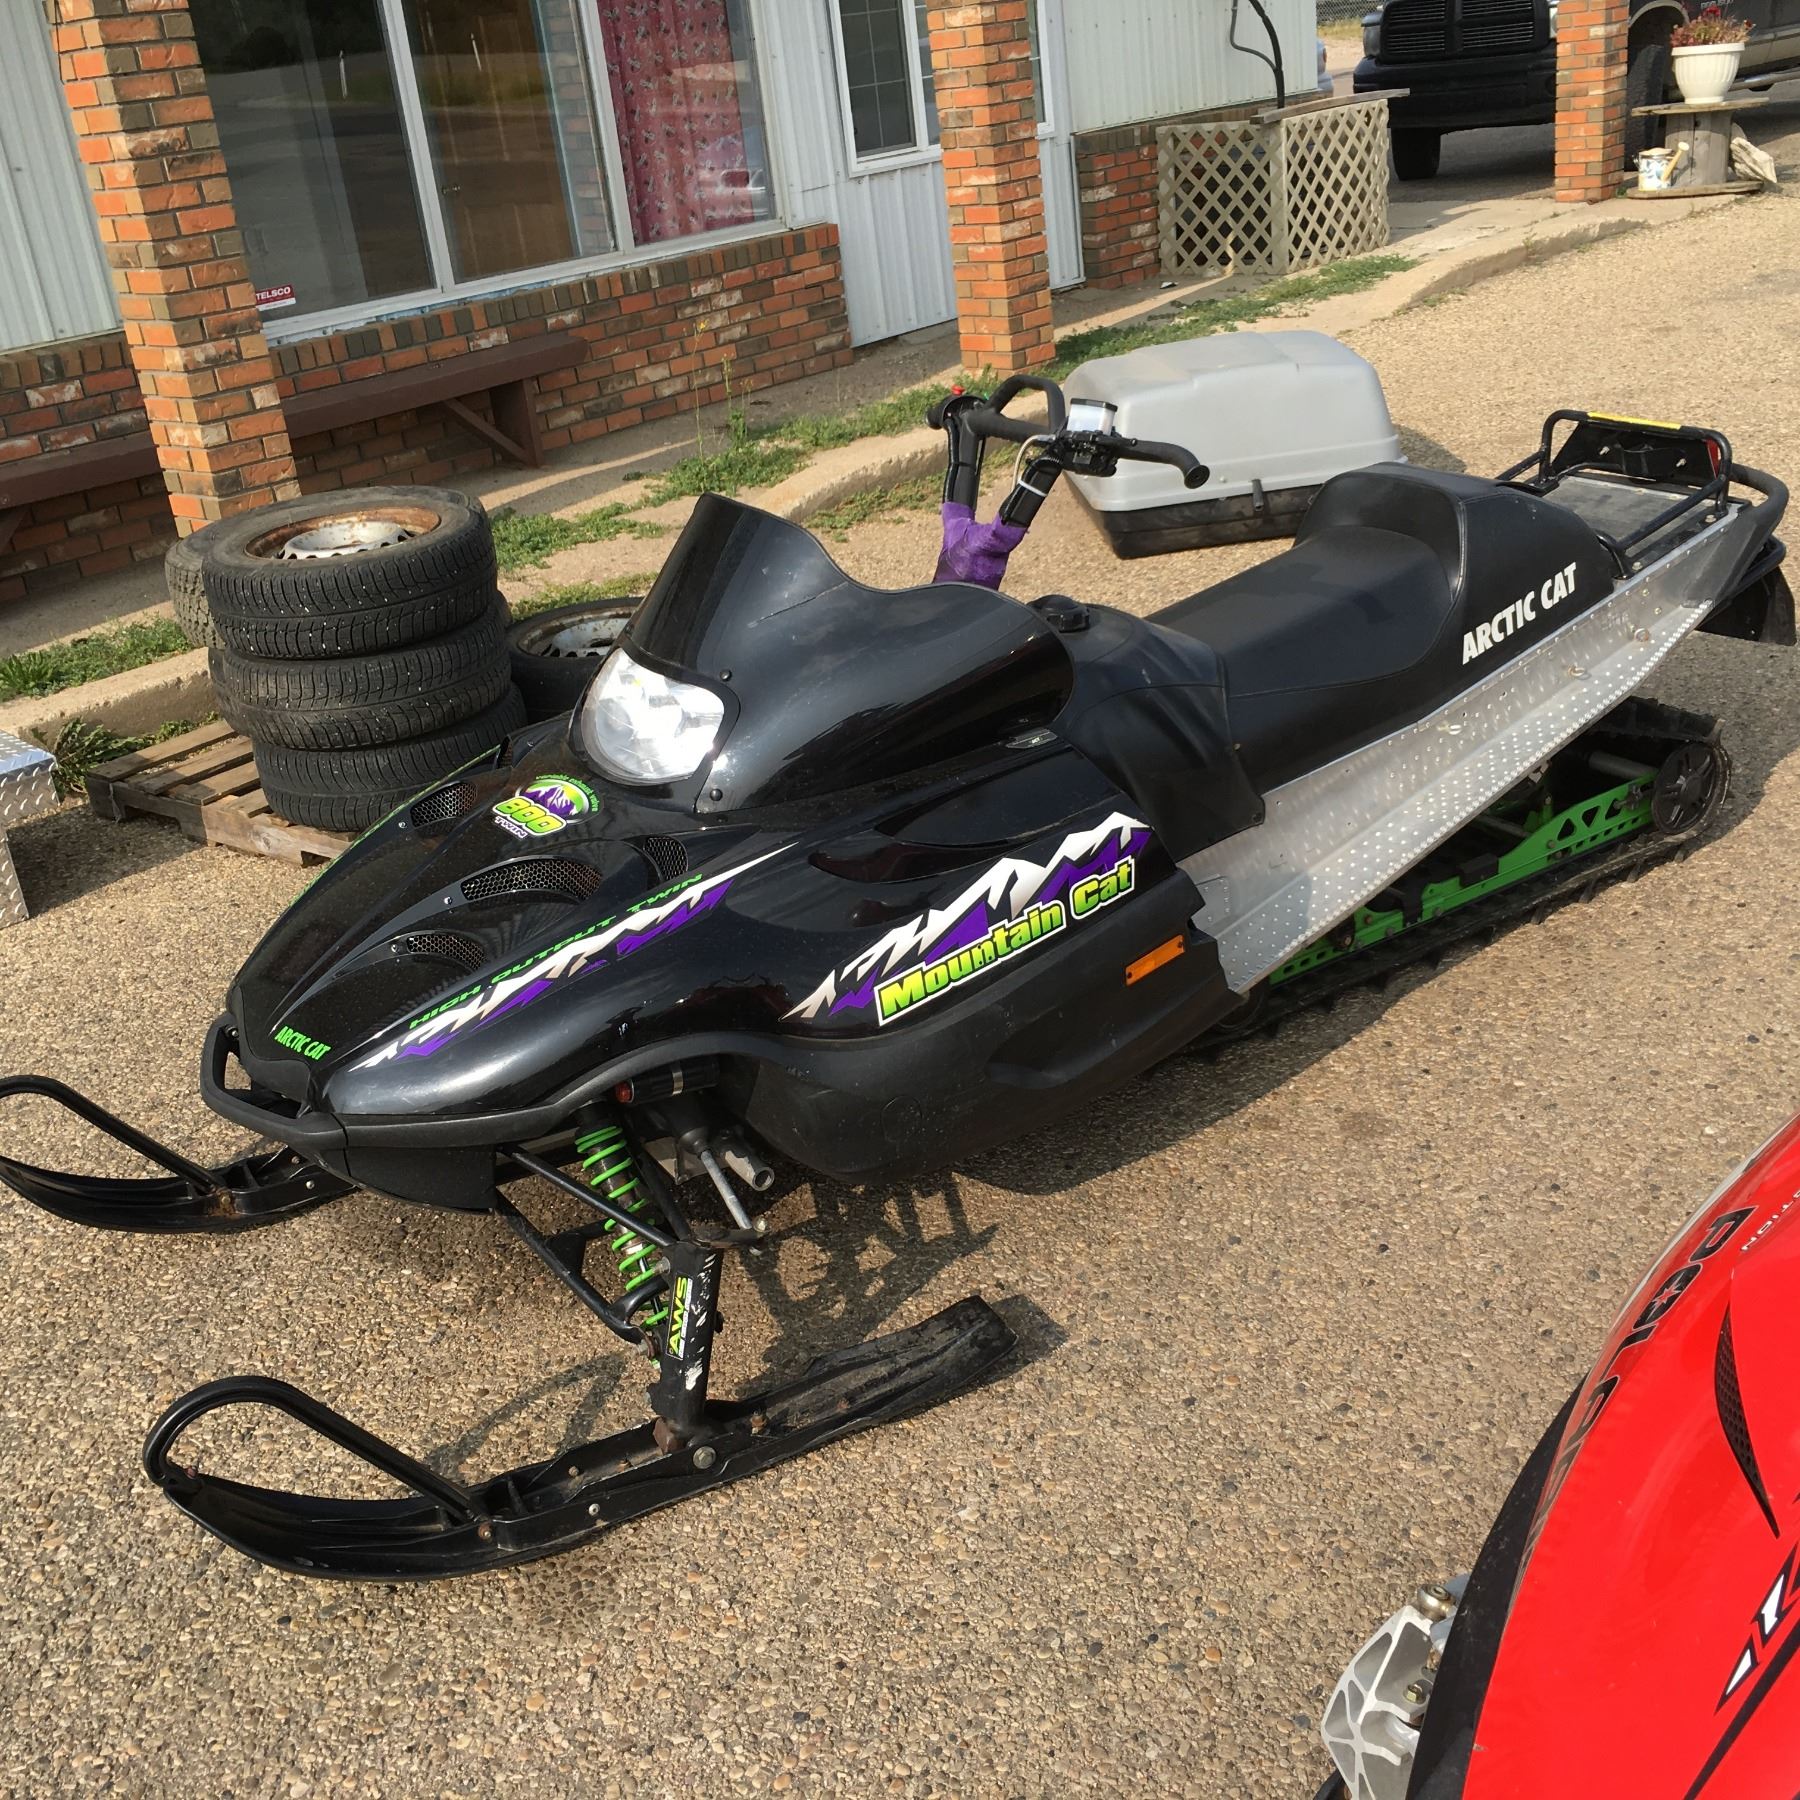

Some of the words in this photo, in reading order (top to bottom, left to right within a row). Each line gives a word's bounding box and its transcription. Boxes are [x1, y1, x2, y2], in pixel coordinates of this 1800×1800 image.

[256, 286, 291, 300] TELSCO
[1462, 590, 1536, 665] ARCTIC
[1540, 561, 1577, 610] CAT
[494, 796, 566, 835] 800
[494, 816, 528, 839] TWIN
[409, 984, 482, 1029] HIGH
[491, 915, 616, 984] OUTPUT
[626, 873, 702, 913] TWIN
[877, 902, 1065, 1020] Mountain
[1071, 858, 1134, 917] Cat
[274, 1025, 312, 1053] ARCTIC
[303, 1041, 332, 1060] CAT
[669, 1276, 688, 1356] AWS
